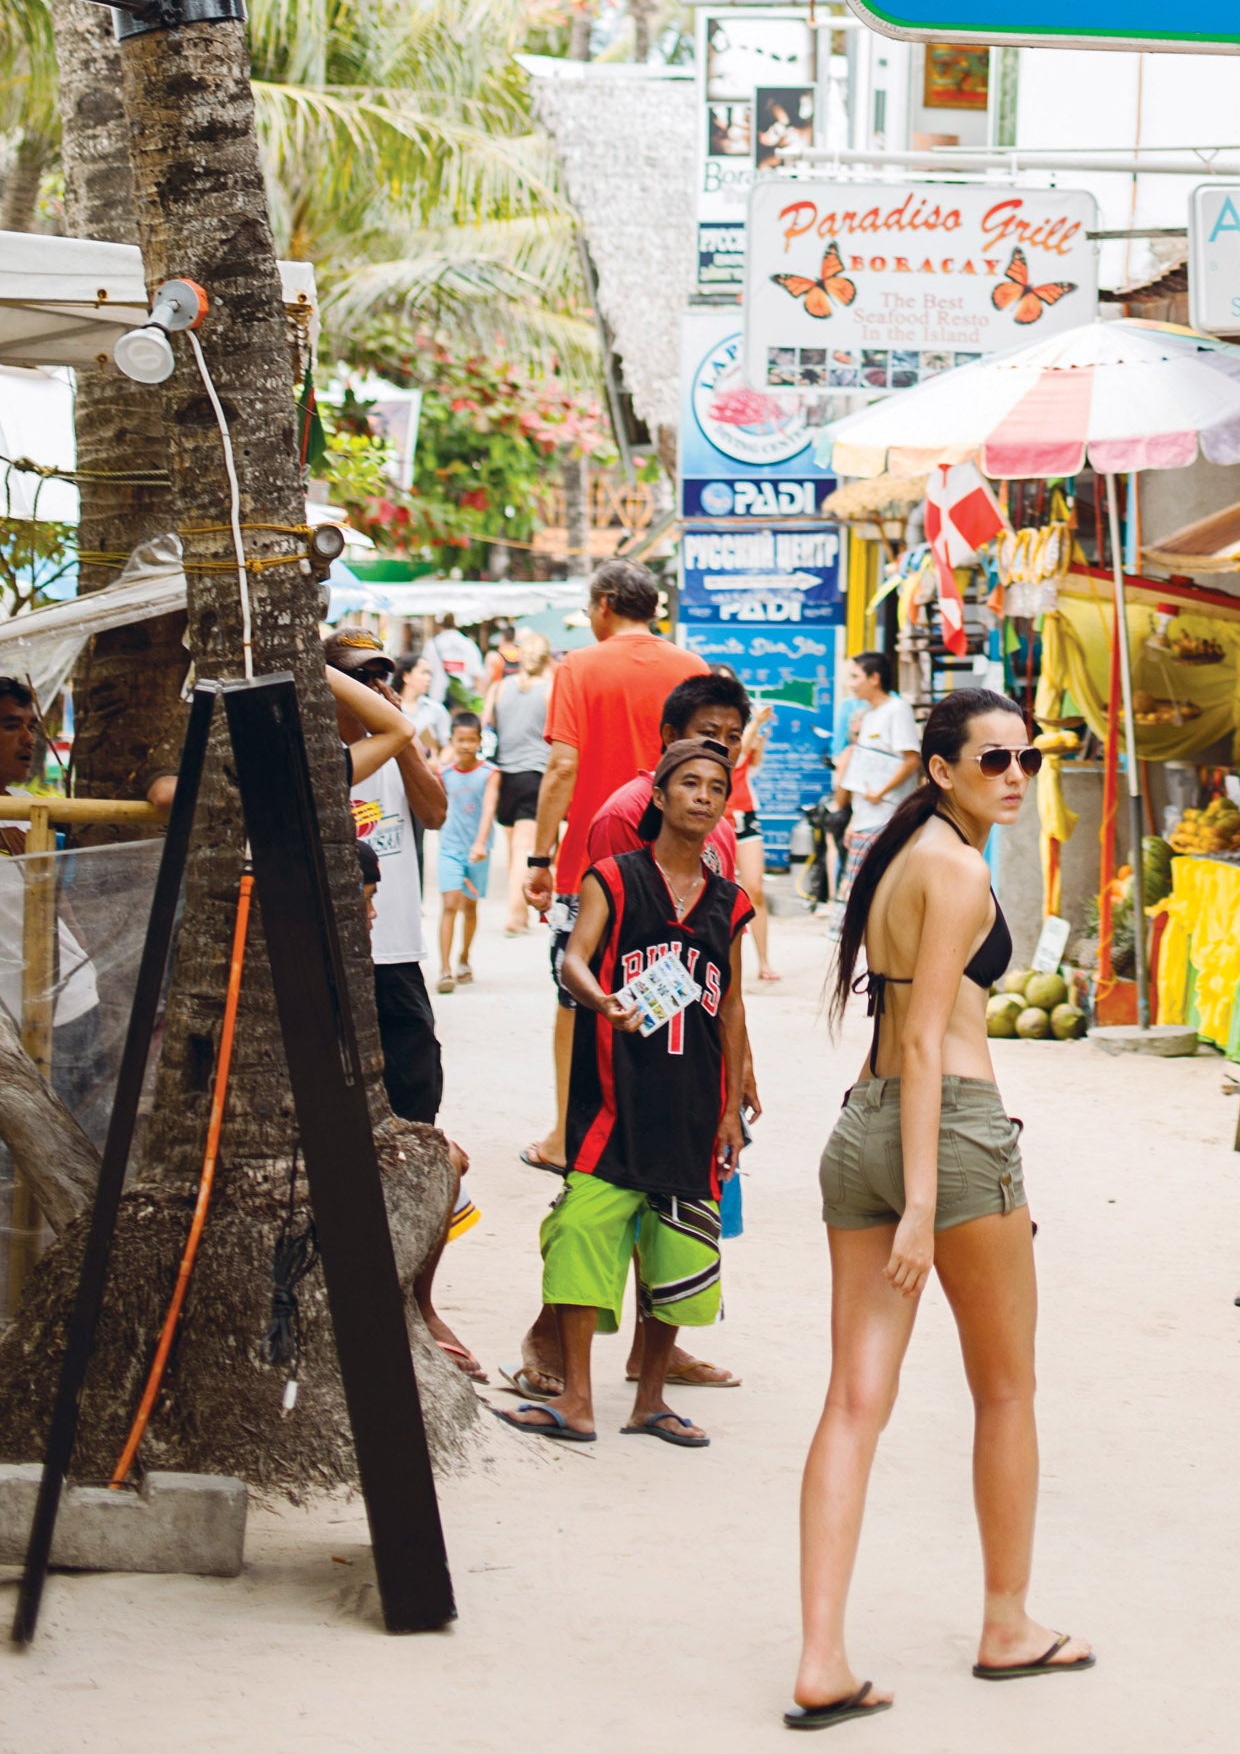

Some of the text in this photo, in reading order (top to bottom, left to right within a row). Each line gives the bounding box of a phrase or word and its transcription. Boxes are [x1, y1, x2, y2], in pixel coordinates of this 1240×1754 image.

[779, 193, 1081, 256] Paradiso Grill
[850, 255, 1003, 276] BORACAY
[880, 292, 964, 310] The Best
[853, 308, 989, 327] Seafood Resto
[862, 325, 980, 343] In the Island
[734, 481, 816, 514] PADI
[719, 600, 801, 621] PADI
